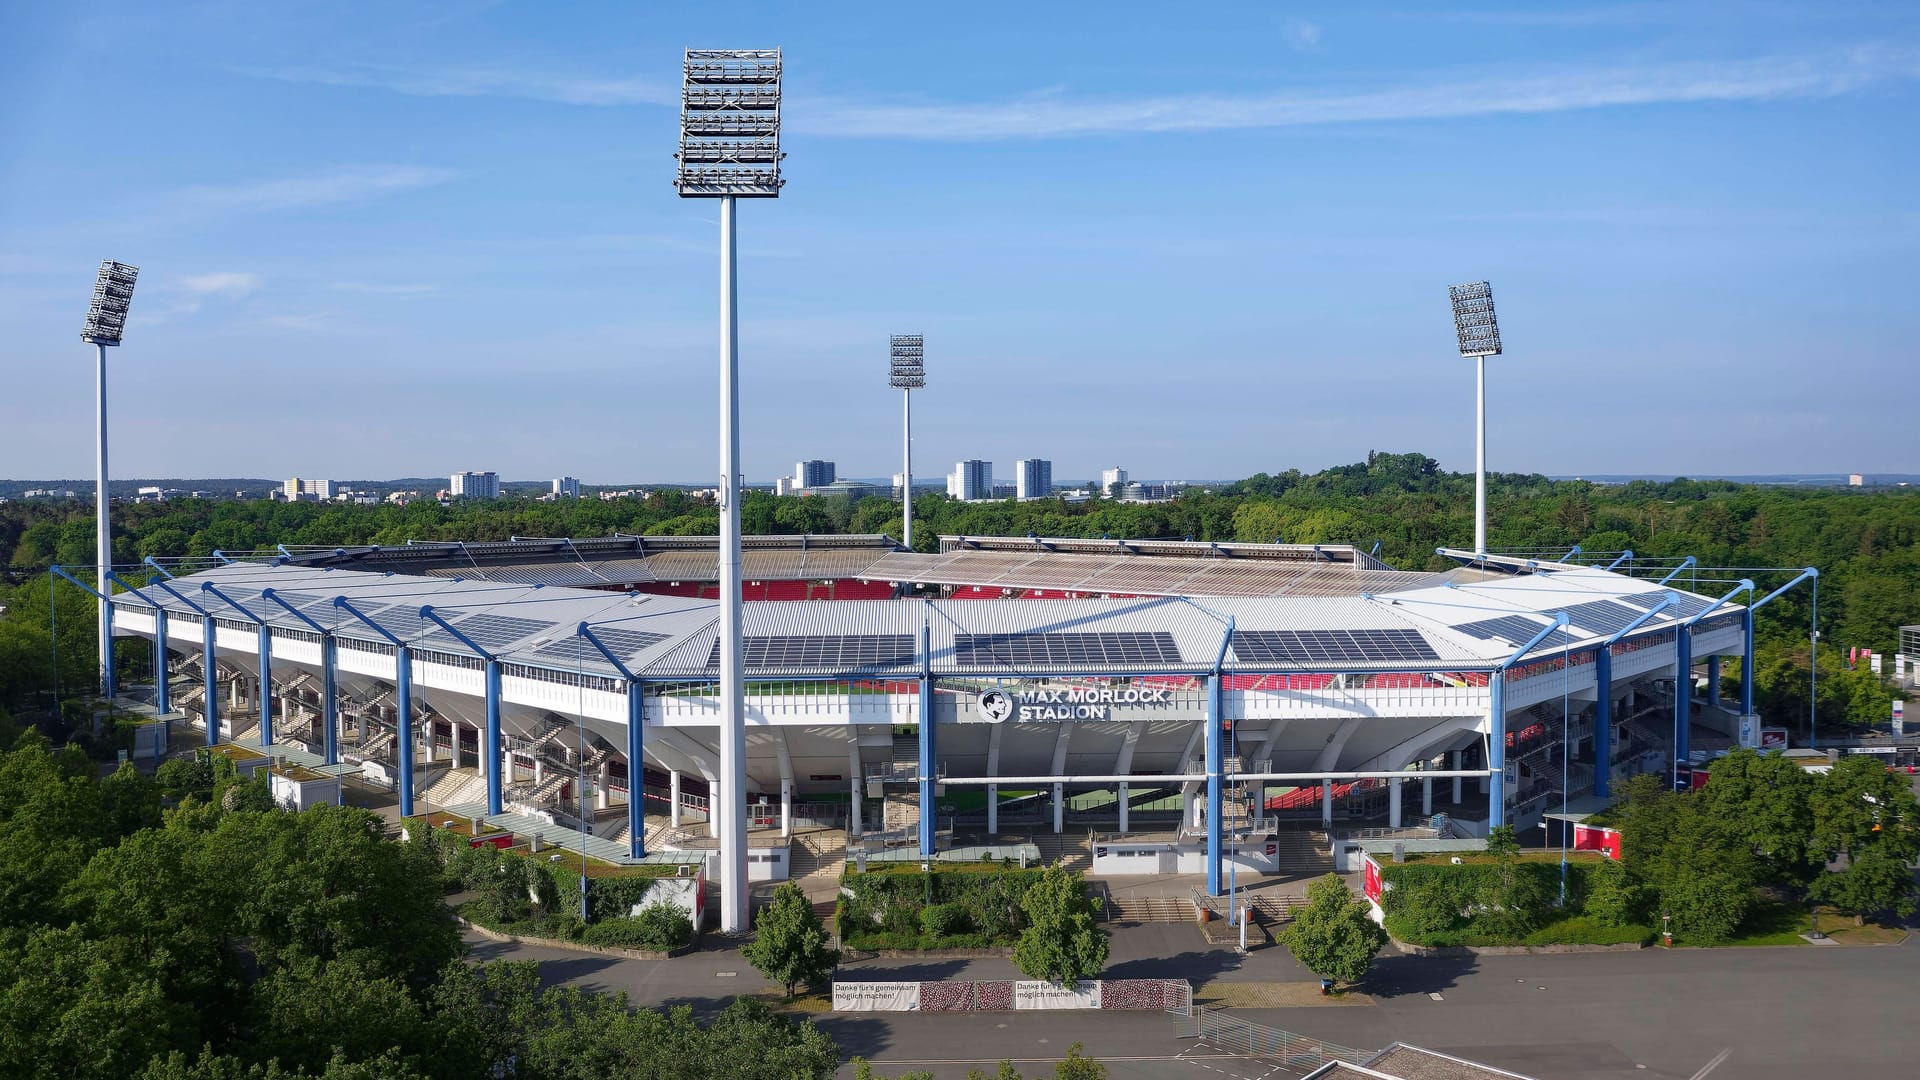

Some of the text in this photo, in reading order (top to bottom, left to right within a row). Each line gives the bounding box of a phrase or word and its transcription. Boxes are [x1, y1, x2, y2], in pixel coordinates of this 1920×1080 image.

[1019, 689, 1166, 704] MAX MORLOCK
[1019, 705, 1104, 719] STADION
[1017, 991, 1045, 999] möglich
